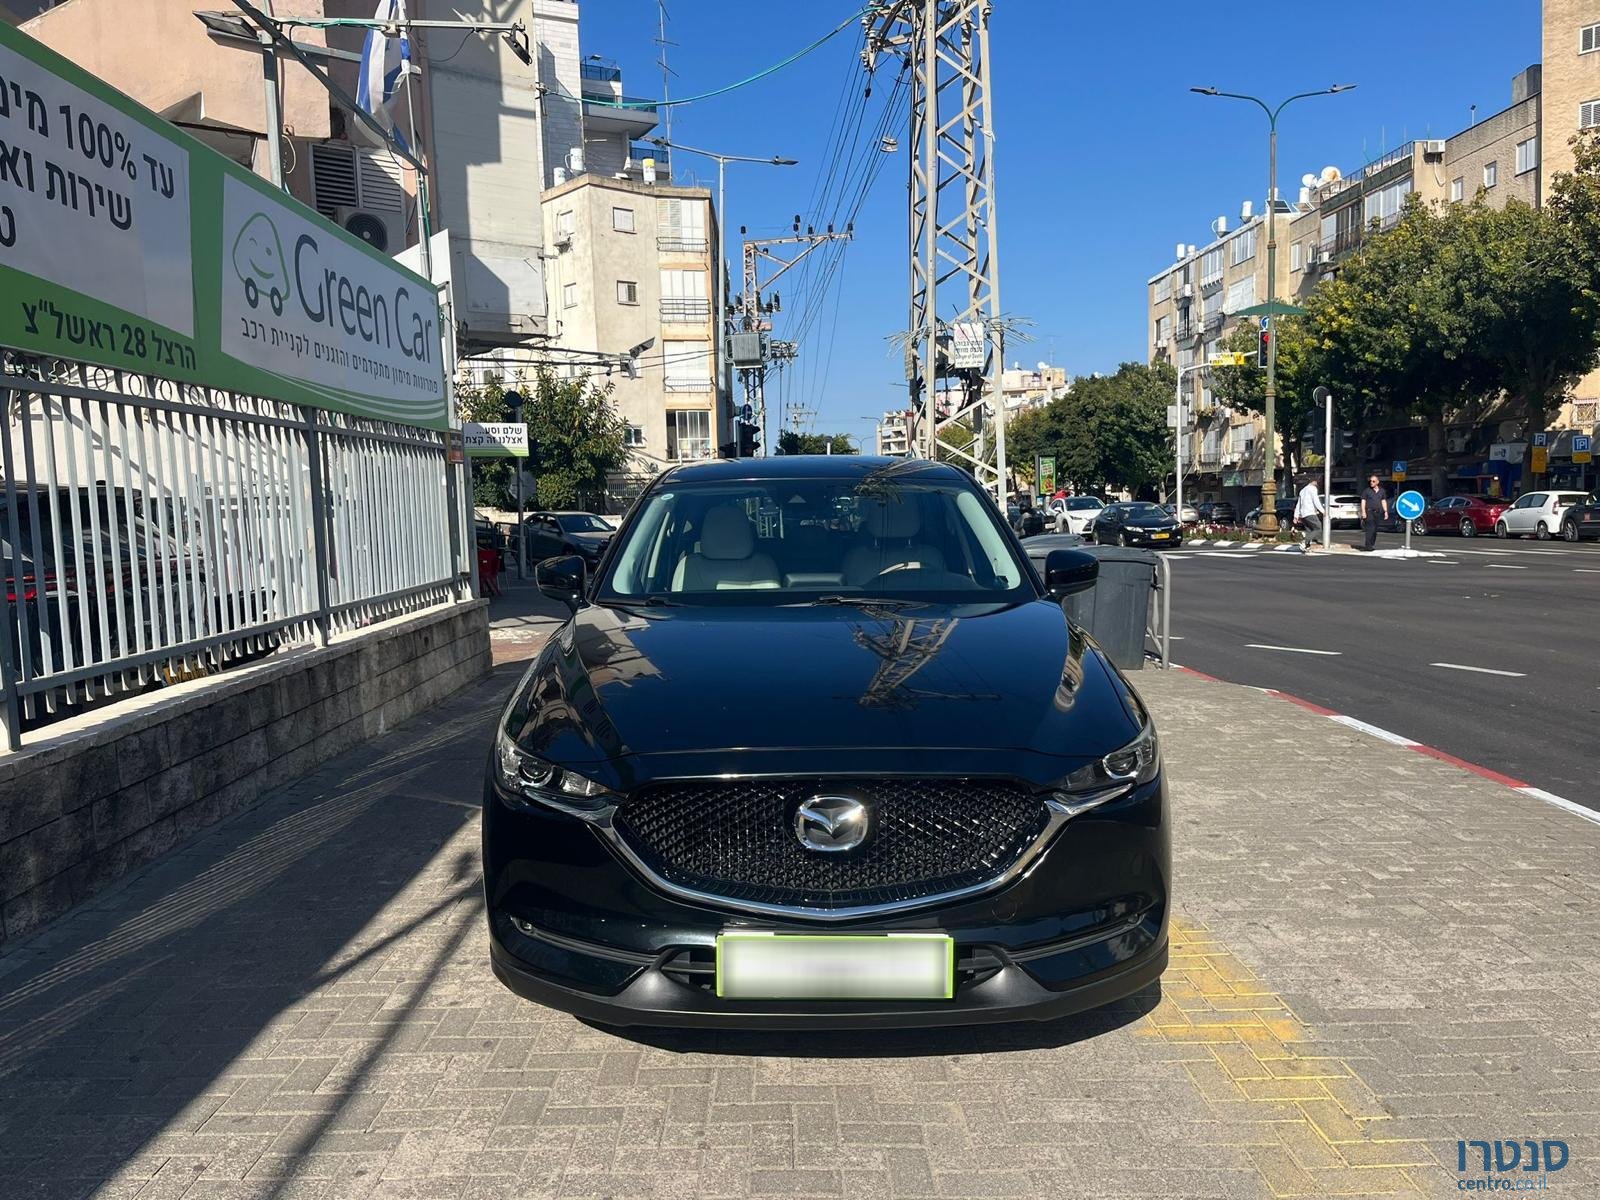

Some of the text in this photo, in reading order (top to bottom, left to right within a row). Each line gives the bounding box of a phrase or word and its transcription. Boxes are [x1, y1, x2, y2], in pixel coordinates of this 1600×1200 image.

[59, 104, 137, 181] 100%
[143, 153, 174, 199] עד
[45, 160, 132, 230] שירות
[294, 233, 432, 364] Green Car
[22, 299, 196, 370] הרצל 28 ראשל"צ
[241, 317, 438, 394] פתרונות מימון מתקדמים והוגנים לקניית רכב
[465, 435, 523, 446] אצלנו זה קצת
[502, 426, 522, 435] שלם
